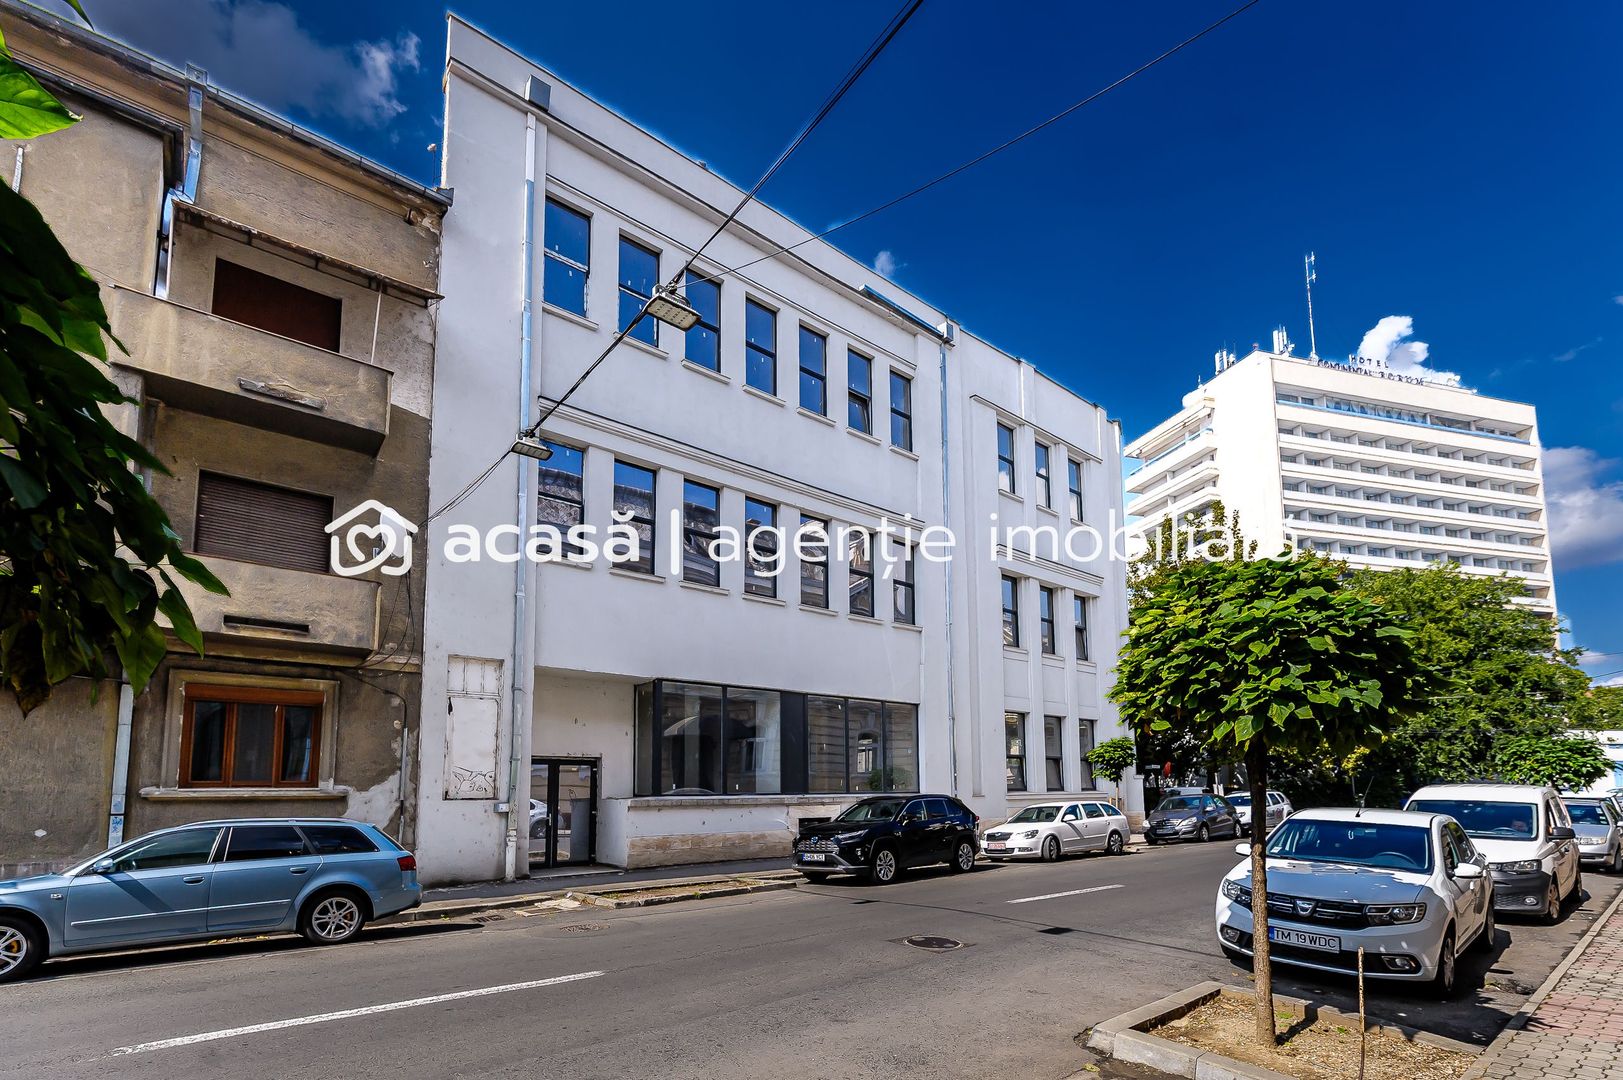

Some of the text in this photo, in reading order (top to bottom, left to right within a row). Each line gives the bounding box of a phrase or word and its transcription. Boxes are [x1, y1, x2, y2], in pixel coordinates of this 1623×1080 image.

[1317, 359, 1373, 377] CONTINENTAL
[1349, 354, 1389, 369] HOTEL
[1275, 929, 1337, 949] TM 19 WDC
